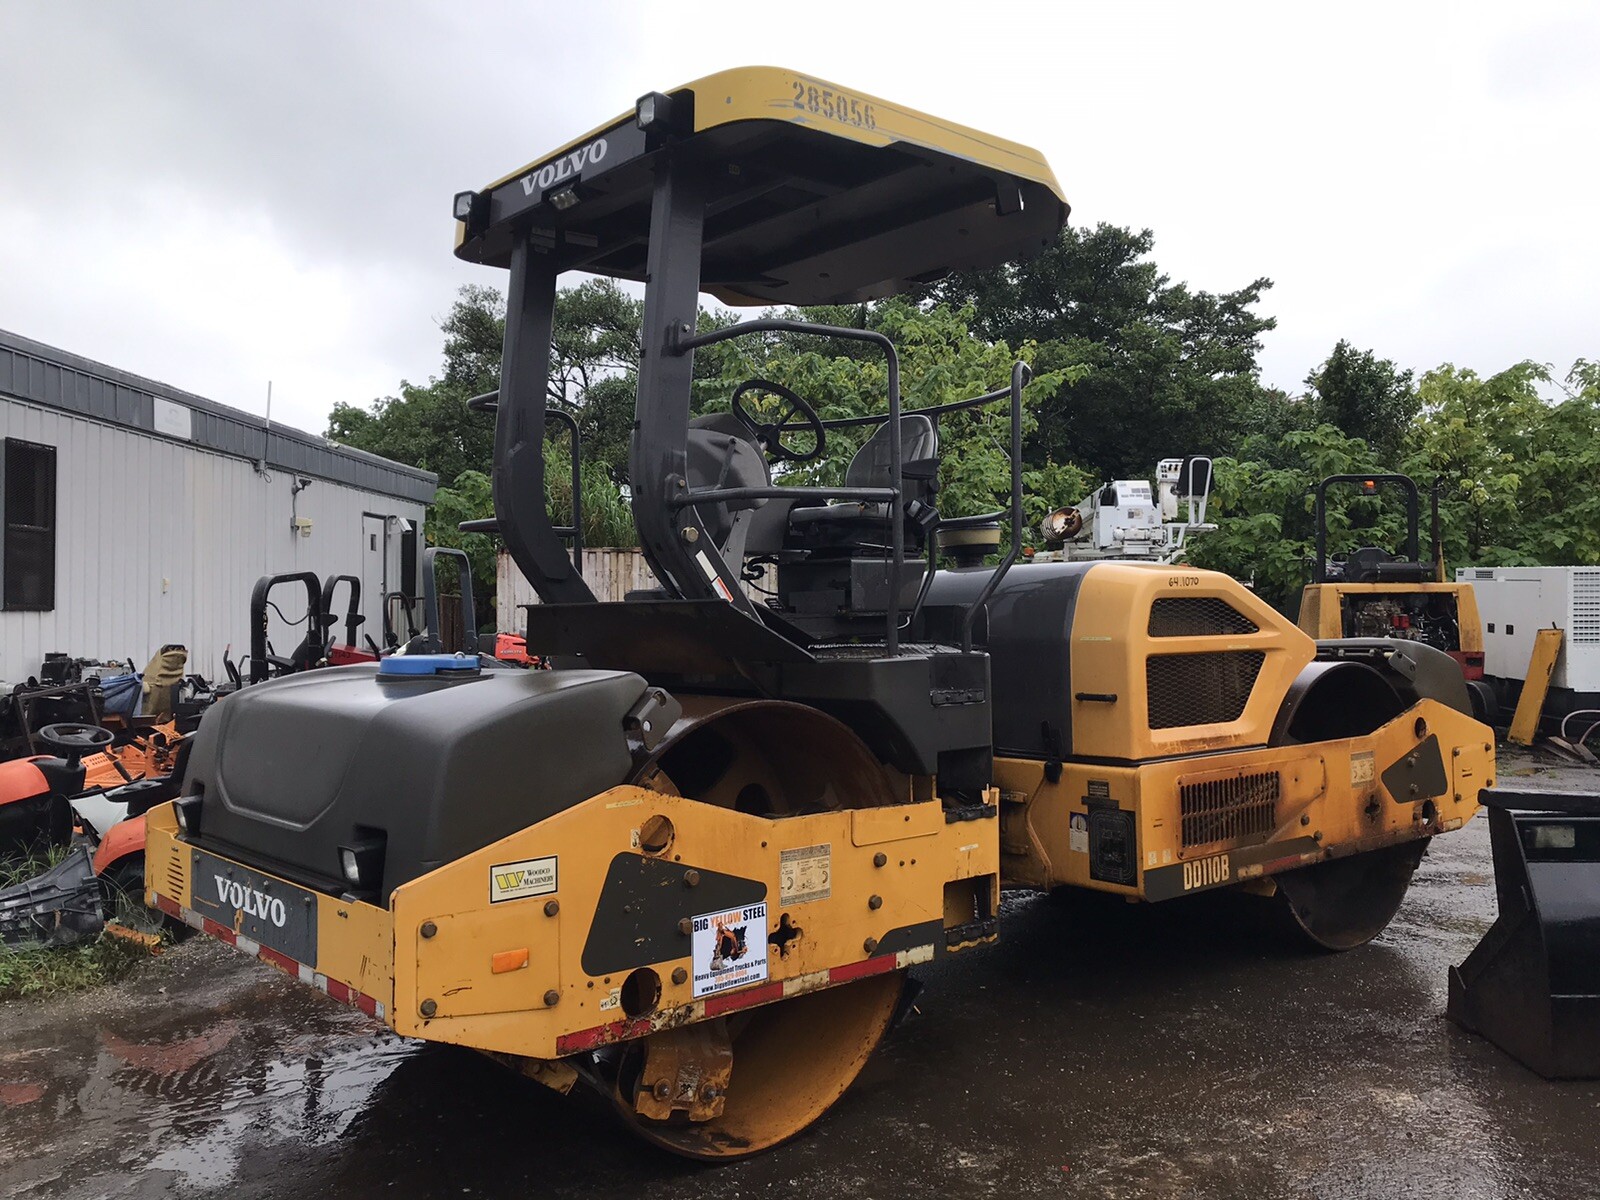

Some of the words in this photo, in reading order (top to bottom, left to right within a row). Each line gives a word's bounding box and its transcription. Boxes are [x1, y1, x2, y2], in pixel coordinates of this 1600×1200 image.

[792, 81, 876, 130] 285056
[519, 138, 608, 196] VOLVO
[1183, 854, 1230, 891] DD110B
[214, 874, 286, 928] VOLVO
[694, 918, 709, 932] BIG
[710, 911, 742, 928] YELLOW
[743, 905, 765, 921] STEEL
[694, 972, 710, 982] Heavy
[710, 966, 734, 978] Equipment
[735, 962, 750, 971] Trucks
[754, 958, 767, 966] Parts
[701, 972, 761, 993] www.bigyellowsteel.com
